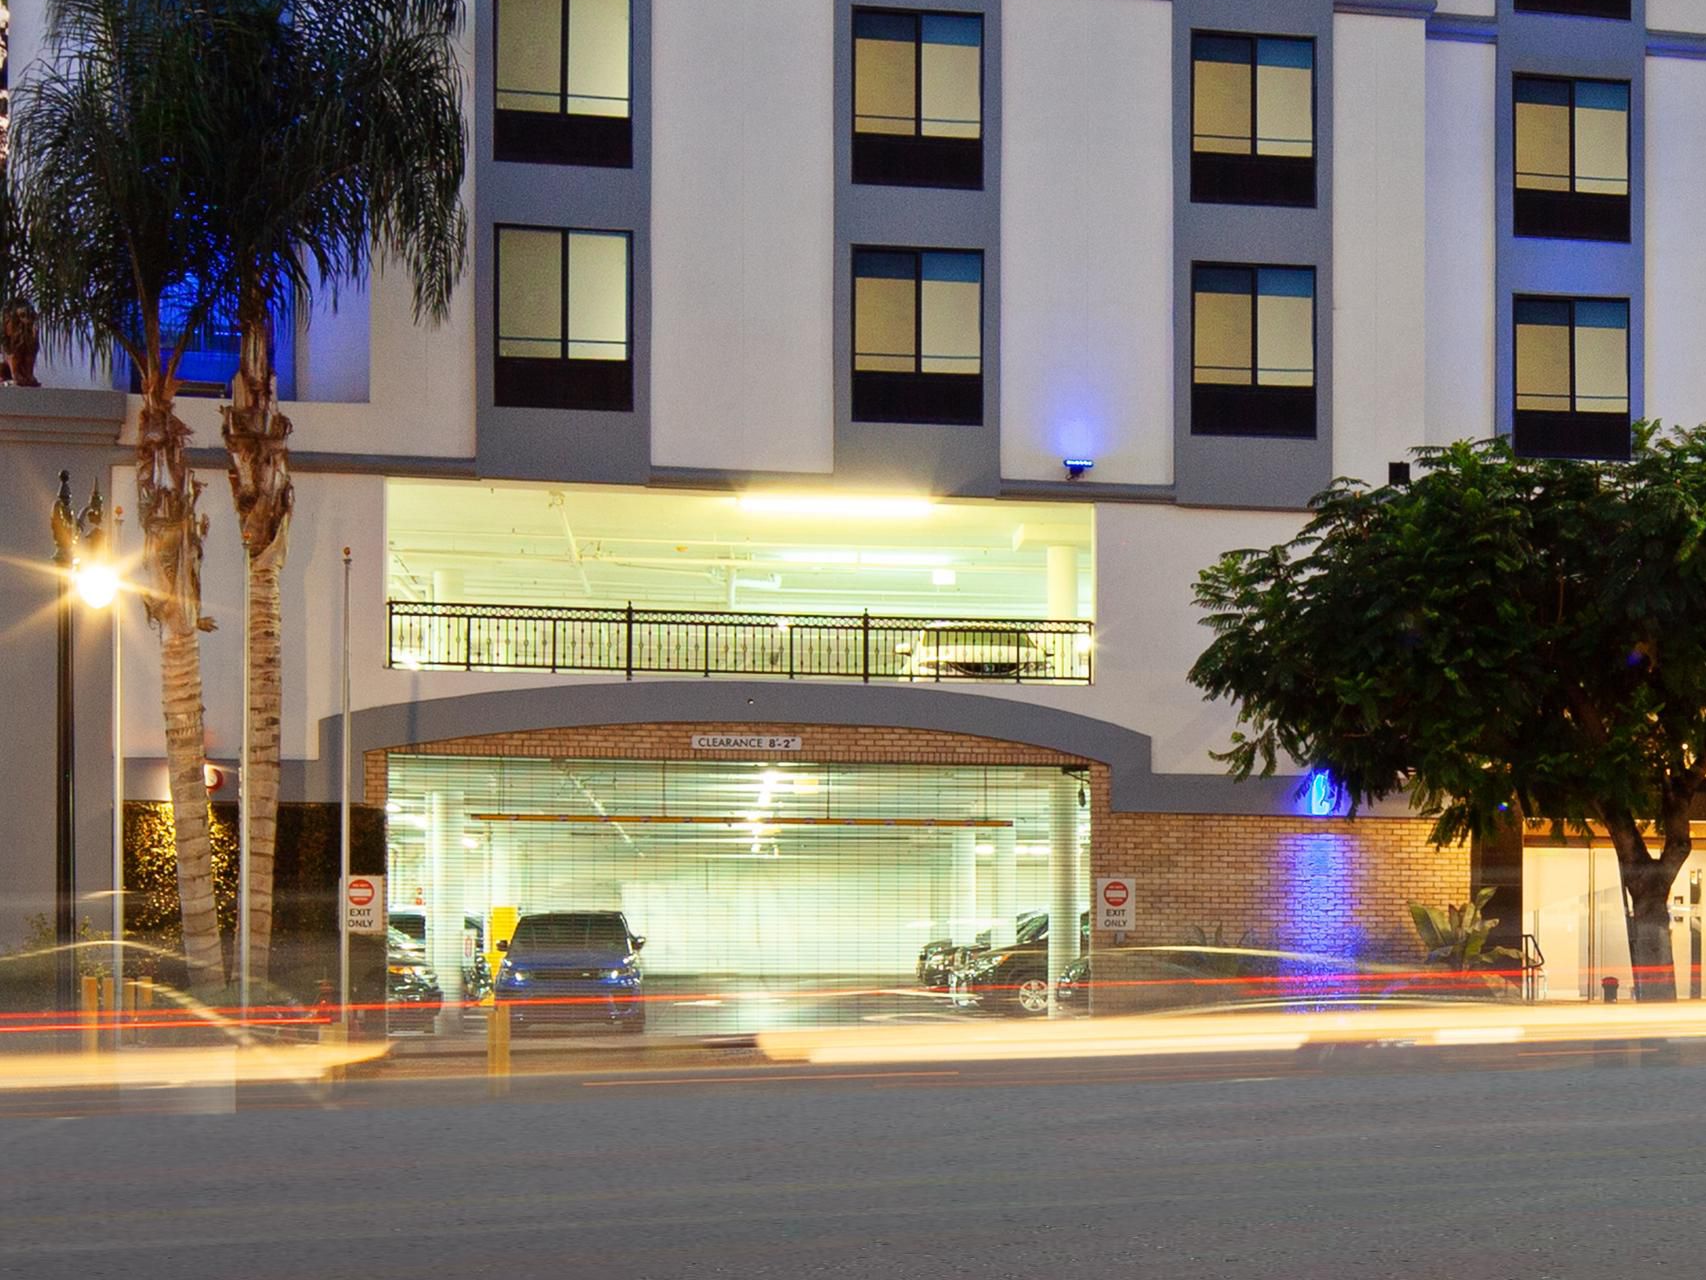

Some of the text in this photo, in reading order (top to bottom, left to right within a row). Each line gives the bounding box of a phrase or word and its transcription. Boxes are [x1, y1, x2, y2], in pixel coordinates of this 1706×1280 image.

[698, 737, 796, 749] CLEARANCE 8'-2"
[350, 908, 371, 916] EXIT
[1105, 909, 1126, 917] EXIT
[348, 920, 373, 928] ONLY
[1104, 919, 1127, 927] ONLY
